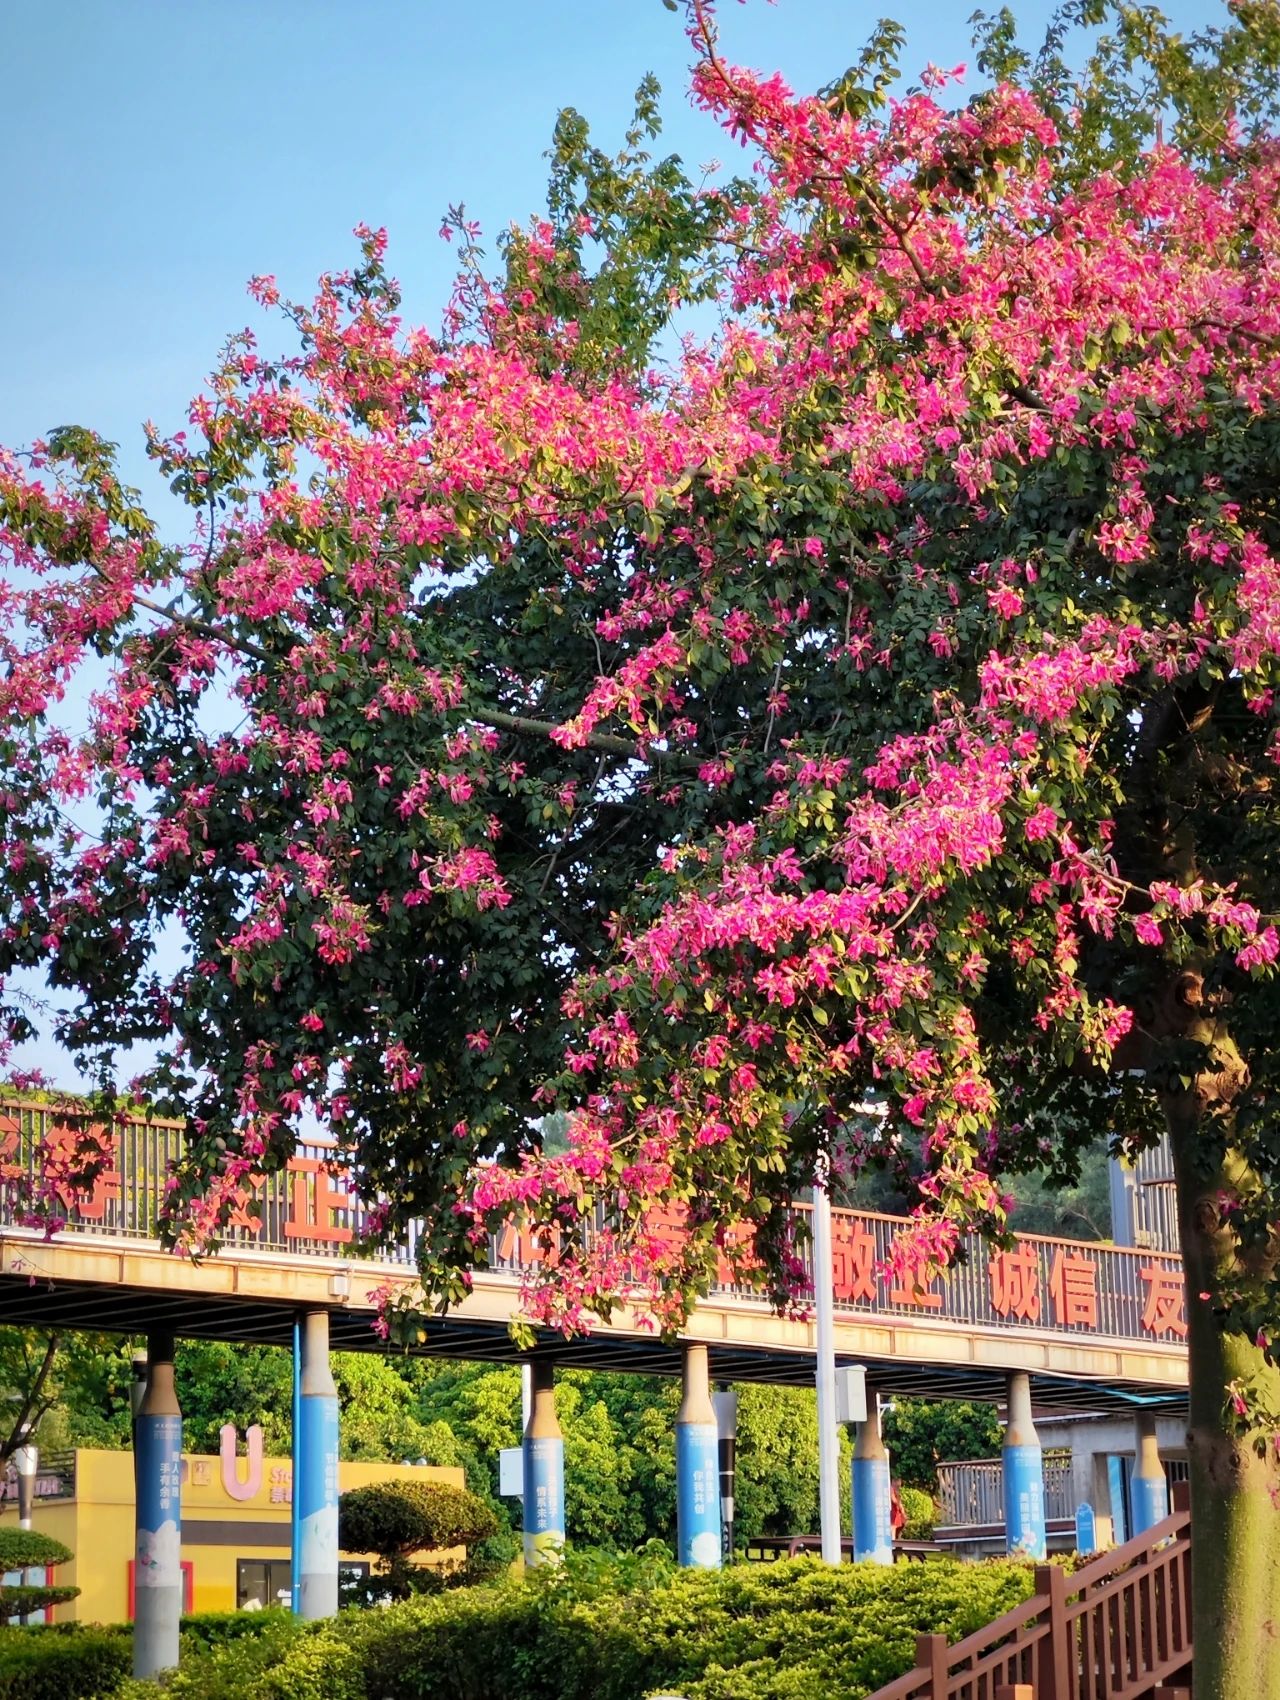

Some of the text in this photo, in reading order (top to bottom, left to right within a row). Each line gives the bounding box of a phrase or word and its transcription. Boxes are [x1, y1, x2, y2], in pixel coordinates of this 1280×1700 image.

[989, 1243, 1097, 1328] 诚信
[1140, 1260, 1188, 1337] 友
[159, 1463, 170, 1509] 手有余香
[220, 1424, 263, 1501] U
